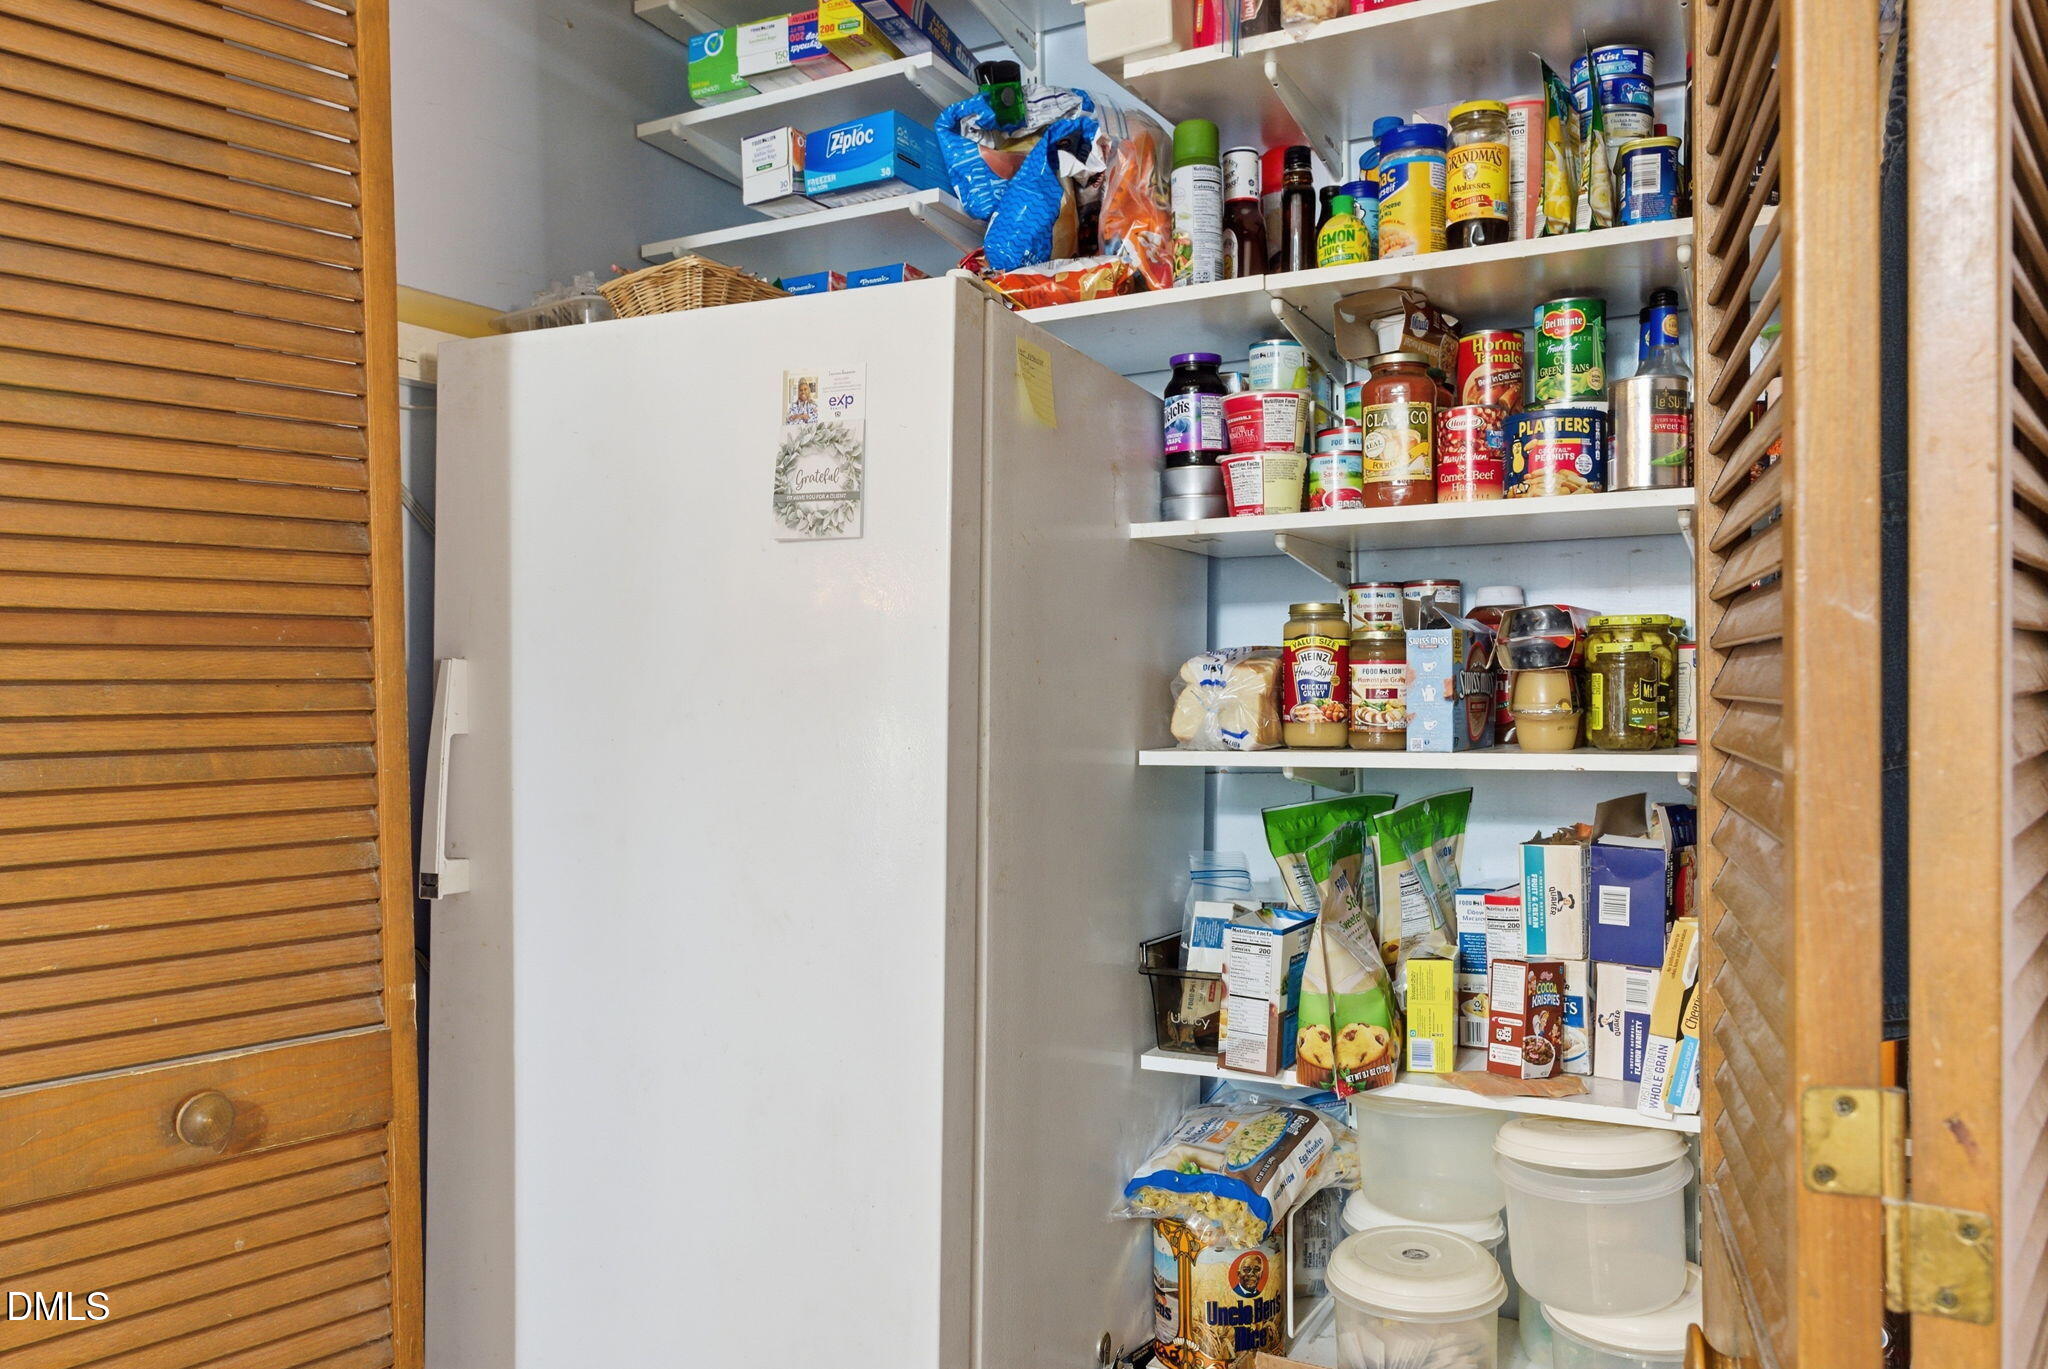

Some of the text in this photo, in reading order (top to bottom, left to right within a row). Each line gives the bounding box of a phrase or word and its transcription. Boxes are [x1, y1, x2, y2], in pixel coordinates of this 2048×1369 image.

[820, 24, 835, 34] 200
[830, 128, 874, 155] Ziploc
[807, 174, 837, 186] FREEZER
[1452, 181, 1491, 193] Molasses
[1319, 229, 1355, 249] LEMON
[1324, 244, 1346, 256] JUICE
[1545, 317, 1583, 329] Del Monte
[1472, 338, 1522, 353] Horme
[1553, 356, 1570, 366] CU
[1539, 363, 1590, 377] GREEN EANS
[829, 394, 854, 409] exp
[1655, 394, 1667, 409] Le
[1366, 410, 1428, 428] CLAICO
[1519, 417, 1592, 438] PLATERS
[1535, 453, 1575, 462] PENUTS
[796, 467, 840, 491] Grateful
[1472, 470, 1494, 480] Beef
[1293, 637, 1336, 648] VALUE SIZE
[1408, 635, 1430, 646] SWISS
[1300, 652, 1329, 663] HEINZ
[1548, 886, 1557, 916] QUAKER
[1232, 927, 1255, 935] Nutrition
[1259, 947, 1271, 955] 200
[1537, 982, 1558, 994] COCOA
[1532, 994, 1560, 1008] KRISPIES
[1635, 1021, 1643, 1048] VARIETY
[1346, 1074, 1354, 1083] NET
[1649, 1044, 1669, 1109] WHOLE GRAIN
[1299, 1151, 1309, 1164] Egg
[1205, 1300, 1253, 1326] Uncle
[1234, 1325, 1267, 1352] Rice
